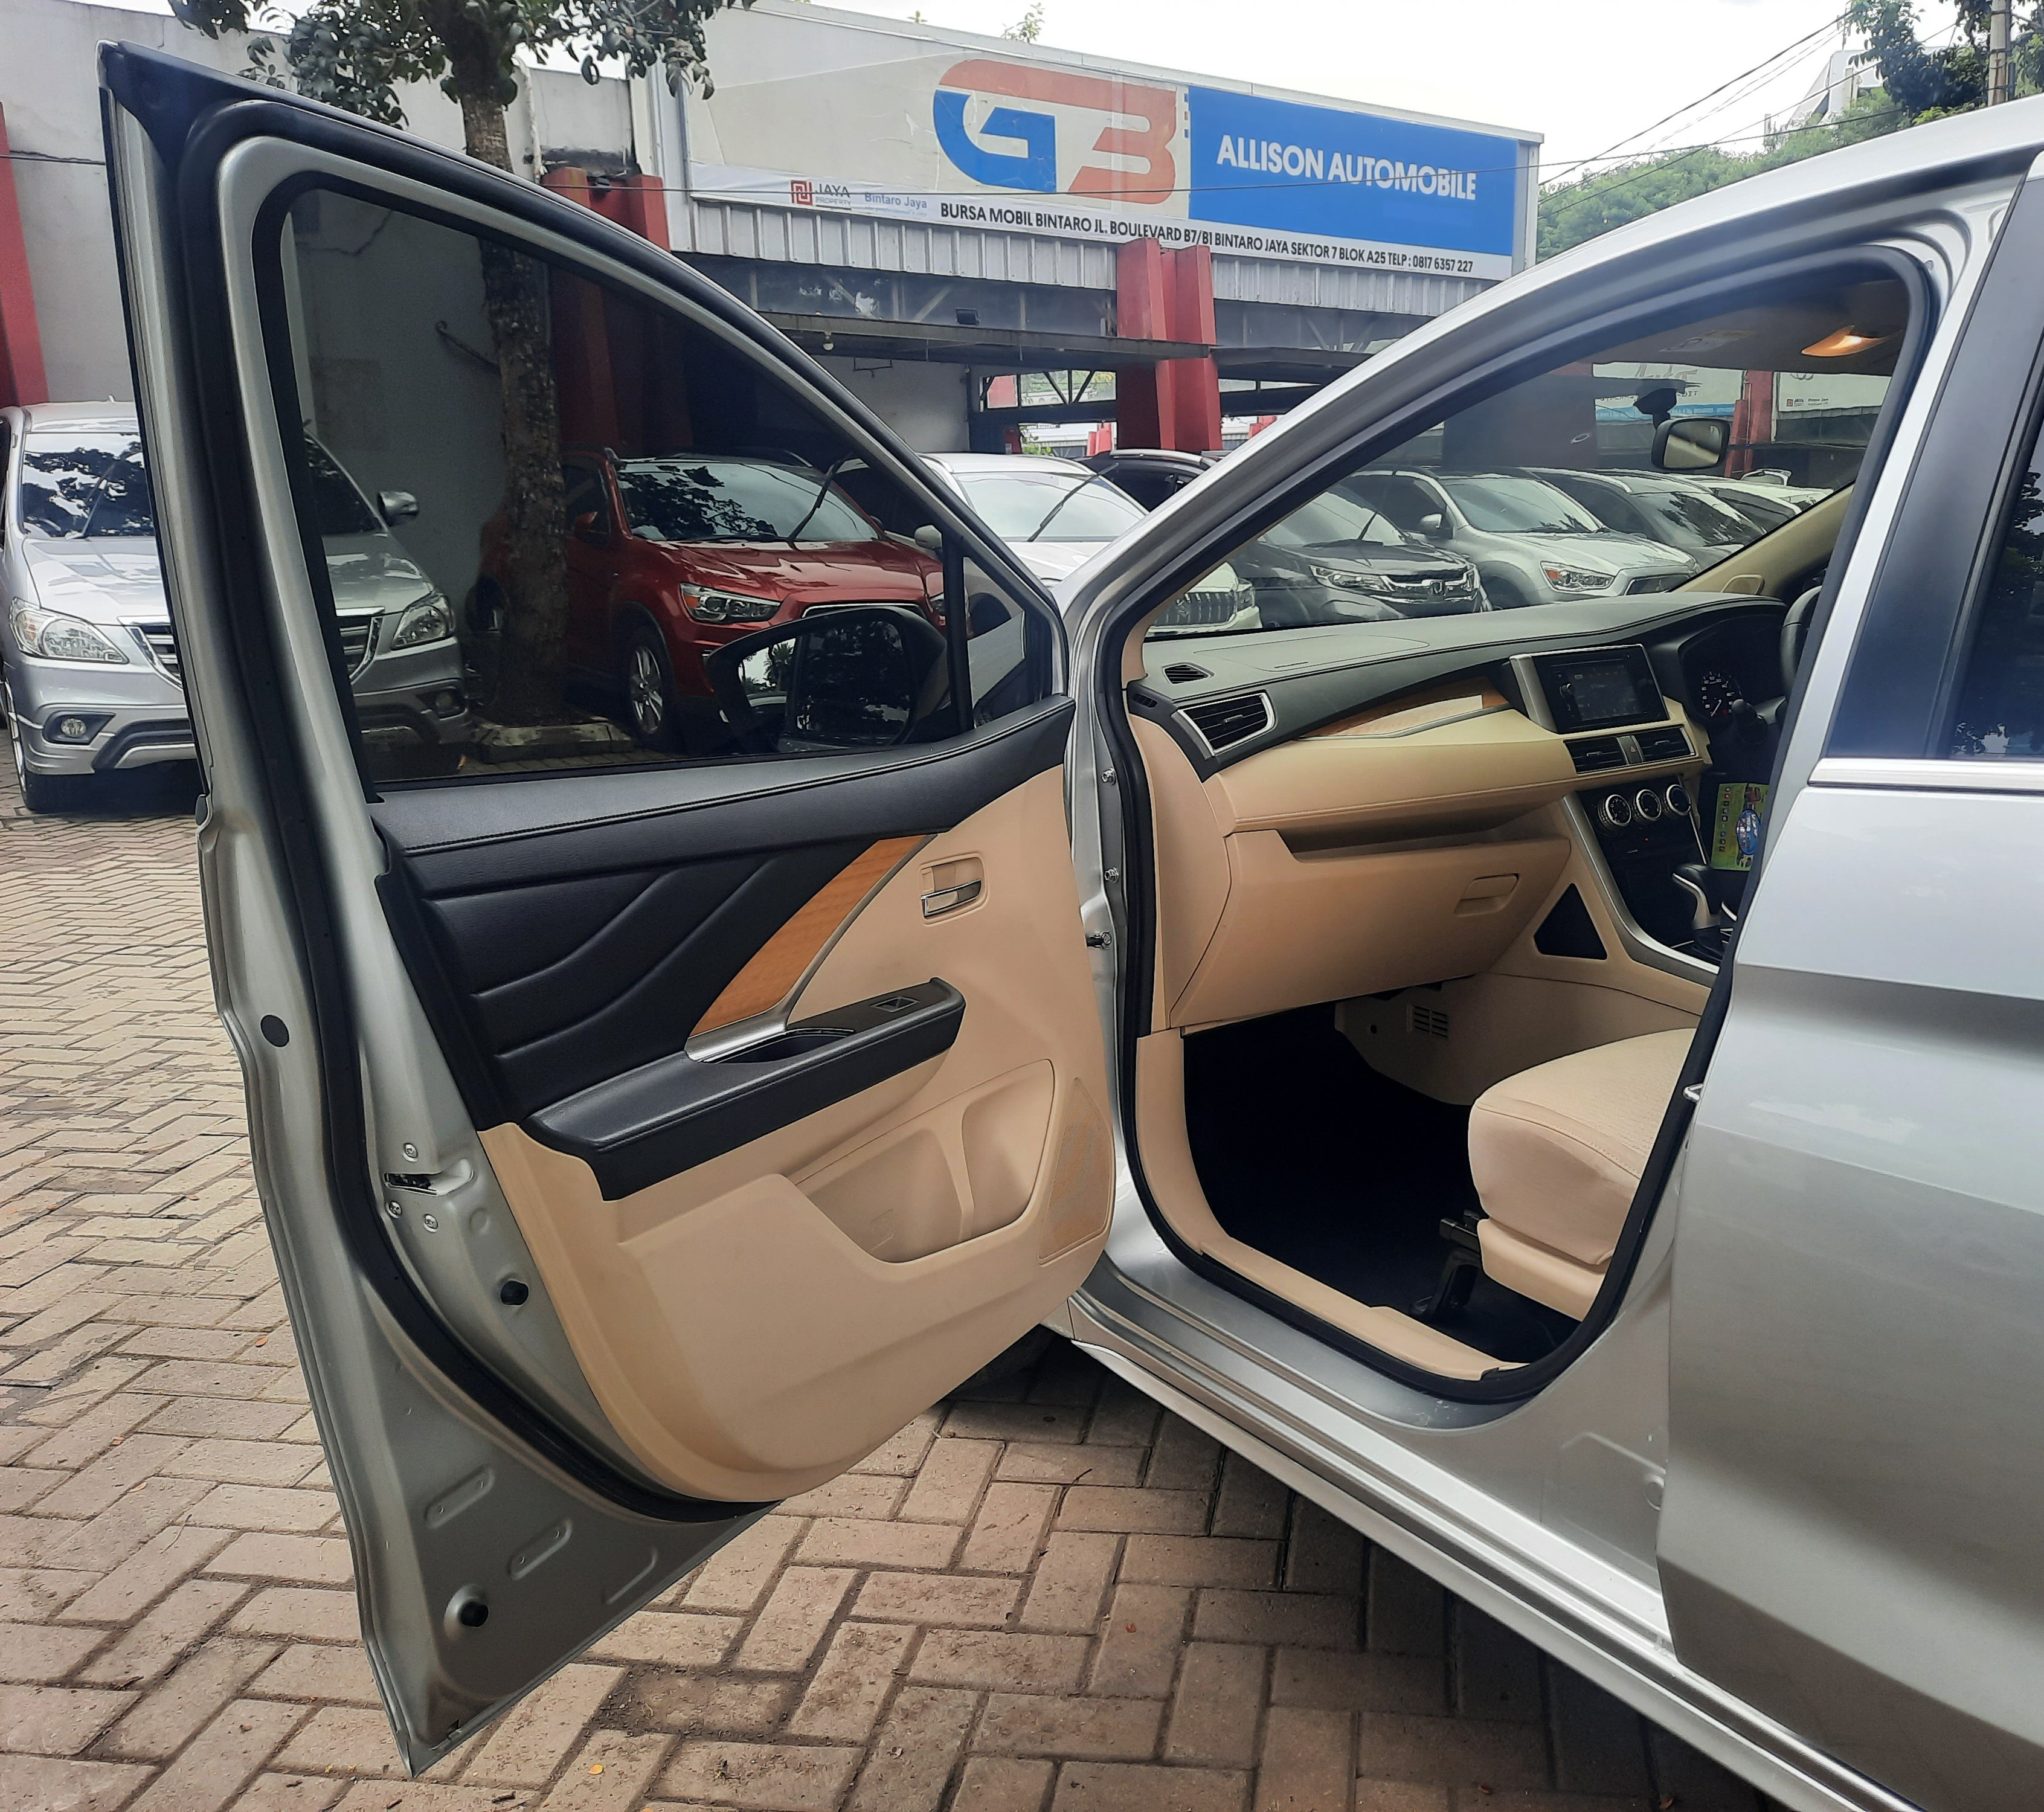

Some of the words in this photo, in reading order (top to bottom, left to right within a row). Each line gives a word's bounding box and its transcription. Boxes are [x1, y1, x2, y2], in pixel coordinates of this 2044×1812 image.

[1216, 135, 1323, 179] ALLISON
[1327, 152, 1477, 200] AUTOMOBILE
[815, 184, 850, 198] JAYA
[865, 193, 901, 207] Bintaro
[904, 198, 927, 210] Jaya
[940, 202, 988, 222] BURSA
[989, 208, 1033, 226] MOBIL
[1036, 213, 1091, 232] BINTARO
[1110, 220, 1182, 241] BOULEVARD
[1215, 232, 1263, 251] BINTARO
[1265, 239, 1289, 254] JAYA
[1291, 242, 1329, 258] SEKTOR
[1331, 246, 1337, 259] 7
[1339, 248, 1365, 262] BLOK
[1366, 250, 1386, 264] A25
[1413, 255, 1432, 268] 0817
[1434, 258, 1456, 271] 6357
[1457, 260, 1473, 272] 227
